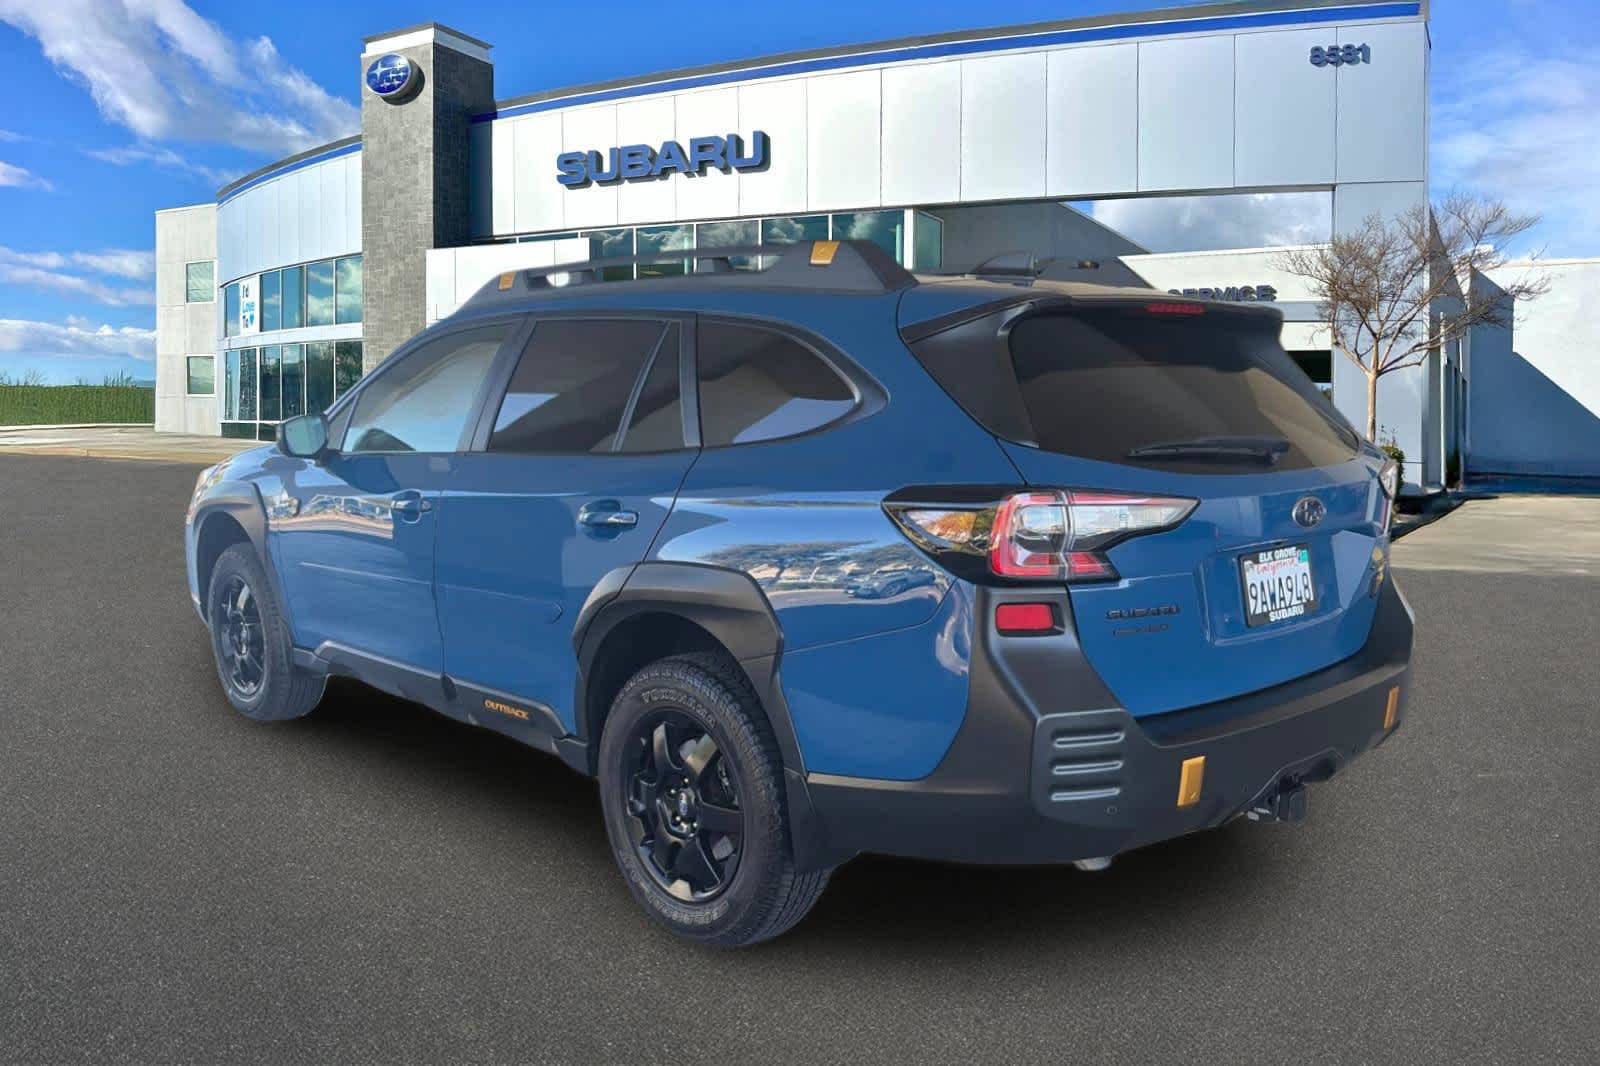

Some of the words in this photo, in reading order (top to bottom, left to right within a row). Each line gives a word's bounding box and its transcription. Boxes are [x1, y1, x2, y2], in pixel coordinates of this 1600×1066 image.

[556, 130, 771, 190] SUBARU
[1249, 572, 1312, 616] 9AWA948
[1105, 605, 1180, 620] SUBARU
[1269, 605, 1305, 622] SUBARU
